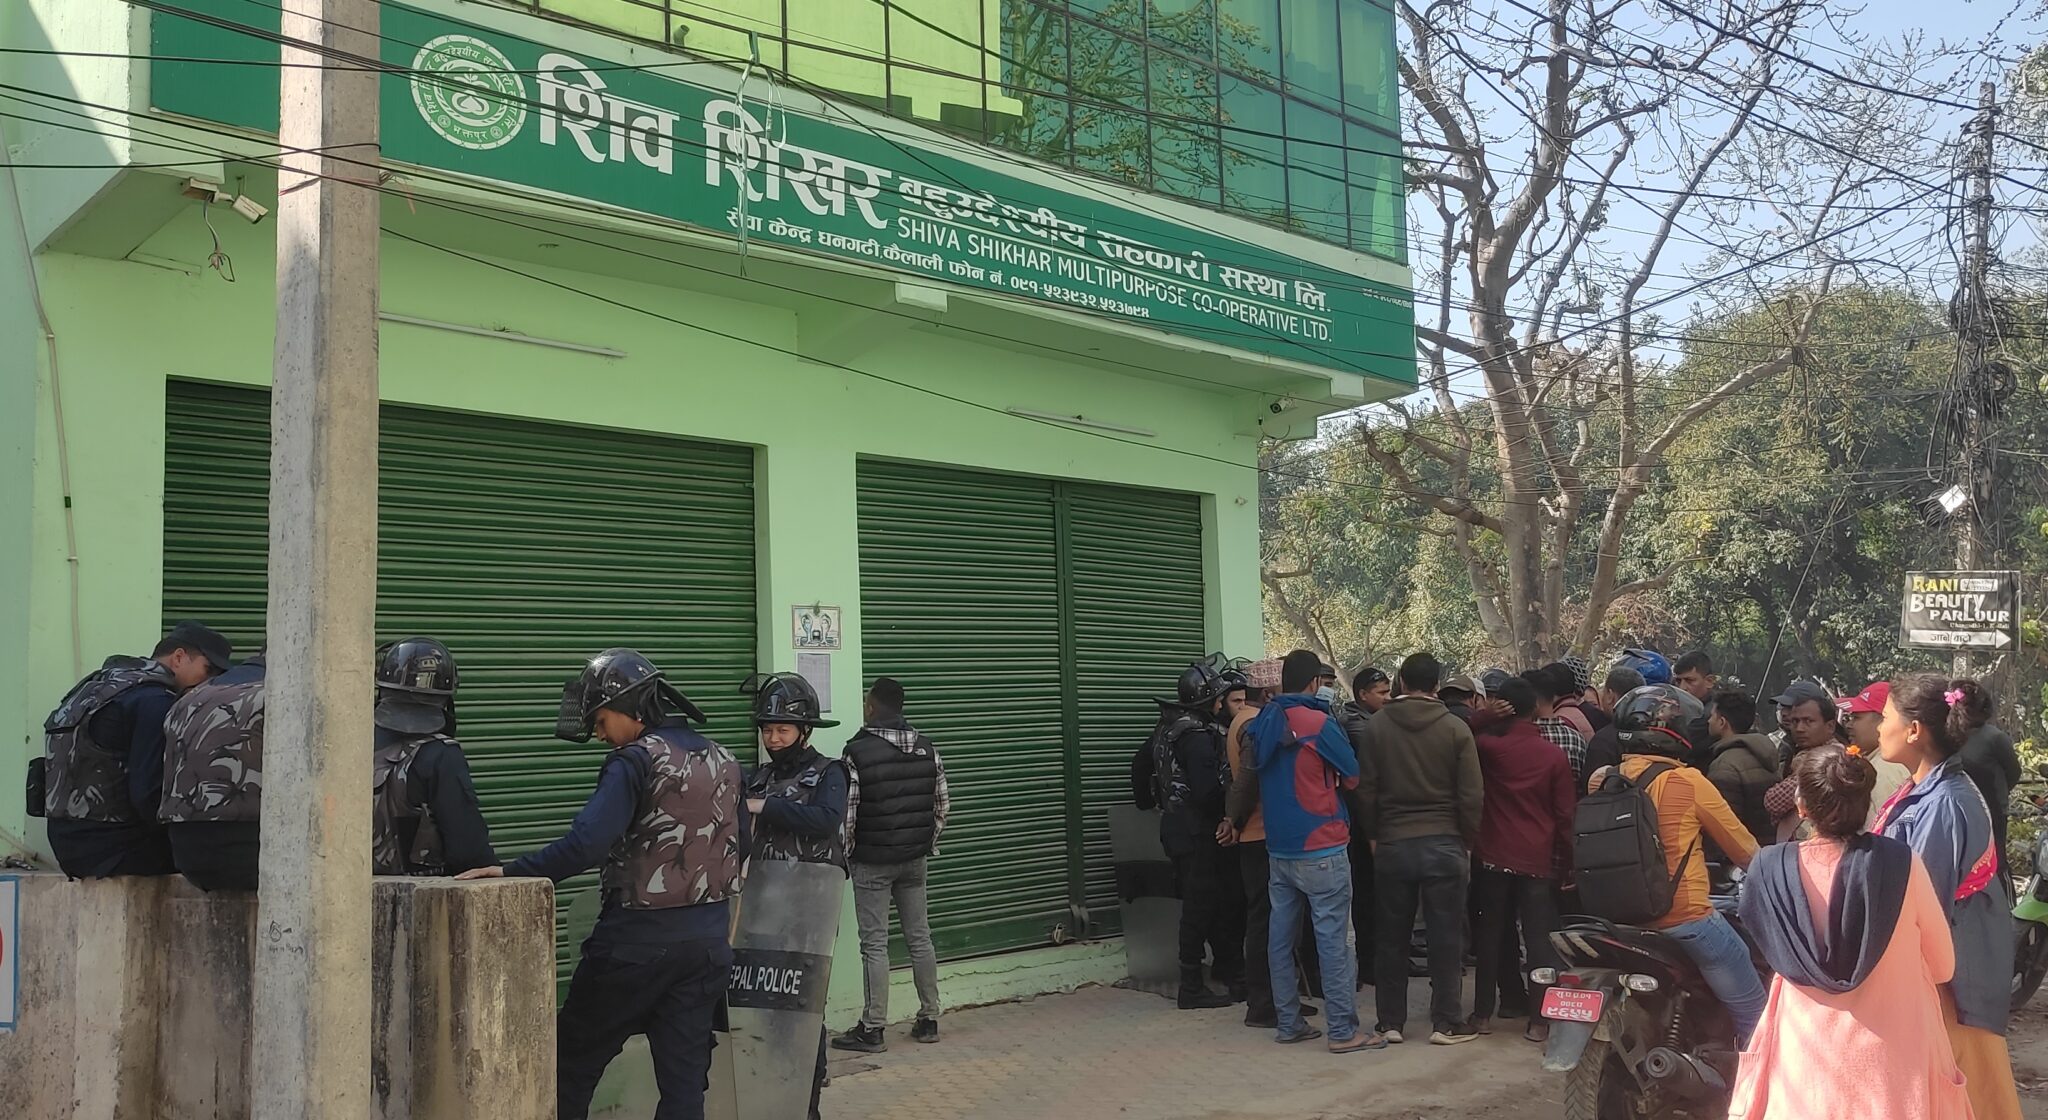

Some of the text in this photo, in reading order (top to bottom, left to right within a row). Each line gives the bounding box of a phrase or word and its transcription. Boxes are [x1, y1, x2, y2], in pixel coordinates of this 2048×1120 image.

[536, 53, 892, 230] शिव शिखर
[726, 207, 763, 232] सेवा
[768, 217, 814, 244] केन्द्र
[948, 260, 985, 282] फोन
[989, 269, 1007, 287] नं.
[1096, 230, 1210, 283] सहकारी
[1294, 280, 1333, 313] लि.
[897, 216, 1333, 343] SHIVA SHIKHAR MULTIPURPOSE CO-OPERATIVE LTD.
[1910, 593, 1986, 613] BEAUTY
[1911, 576, 1959, 593] RANI
[1929, 608, 2010, 622] PARLOUR
[755, 966, 803, 995] POLICE
